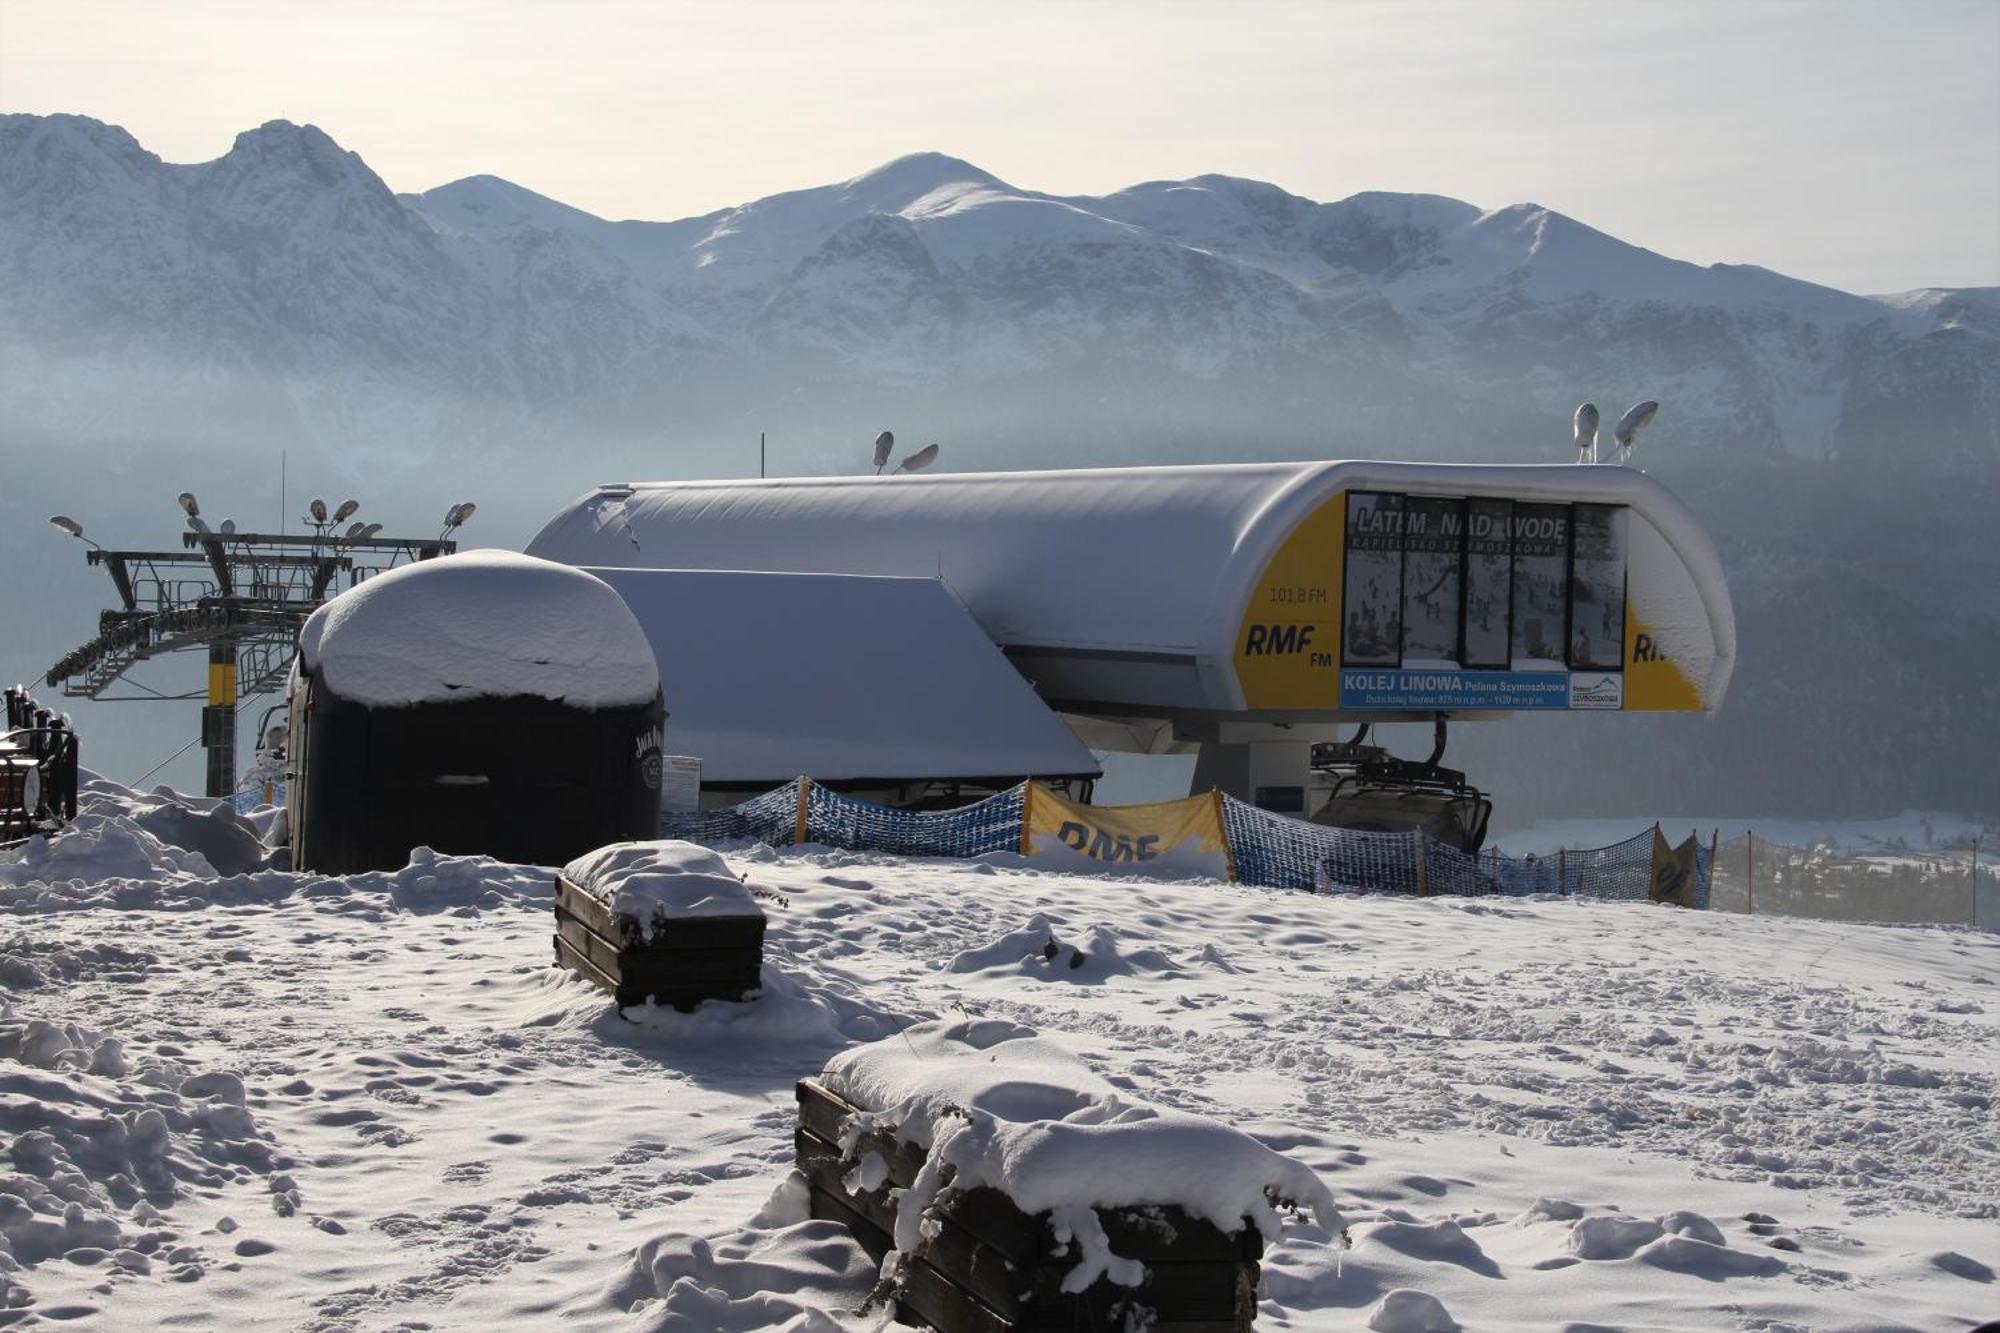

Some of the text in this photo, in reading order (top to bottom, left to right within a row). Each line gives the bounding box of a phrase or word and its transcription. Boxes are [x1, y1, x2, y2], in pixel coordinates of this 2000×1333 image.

[1358, 509, 1567, 545] LATEM NAD WODĘ
[1308, 588, 1327, 603] FM
[1245, 624, 1315, 656] RMF
[1310, 652, 1332, 667] FM
[1344, 675, 1566, 693] KOLEJ LINOWA Polana Szymoszkowa
